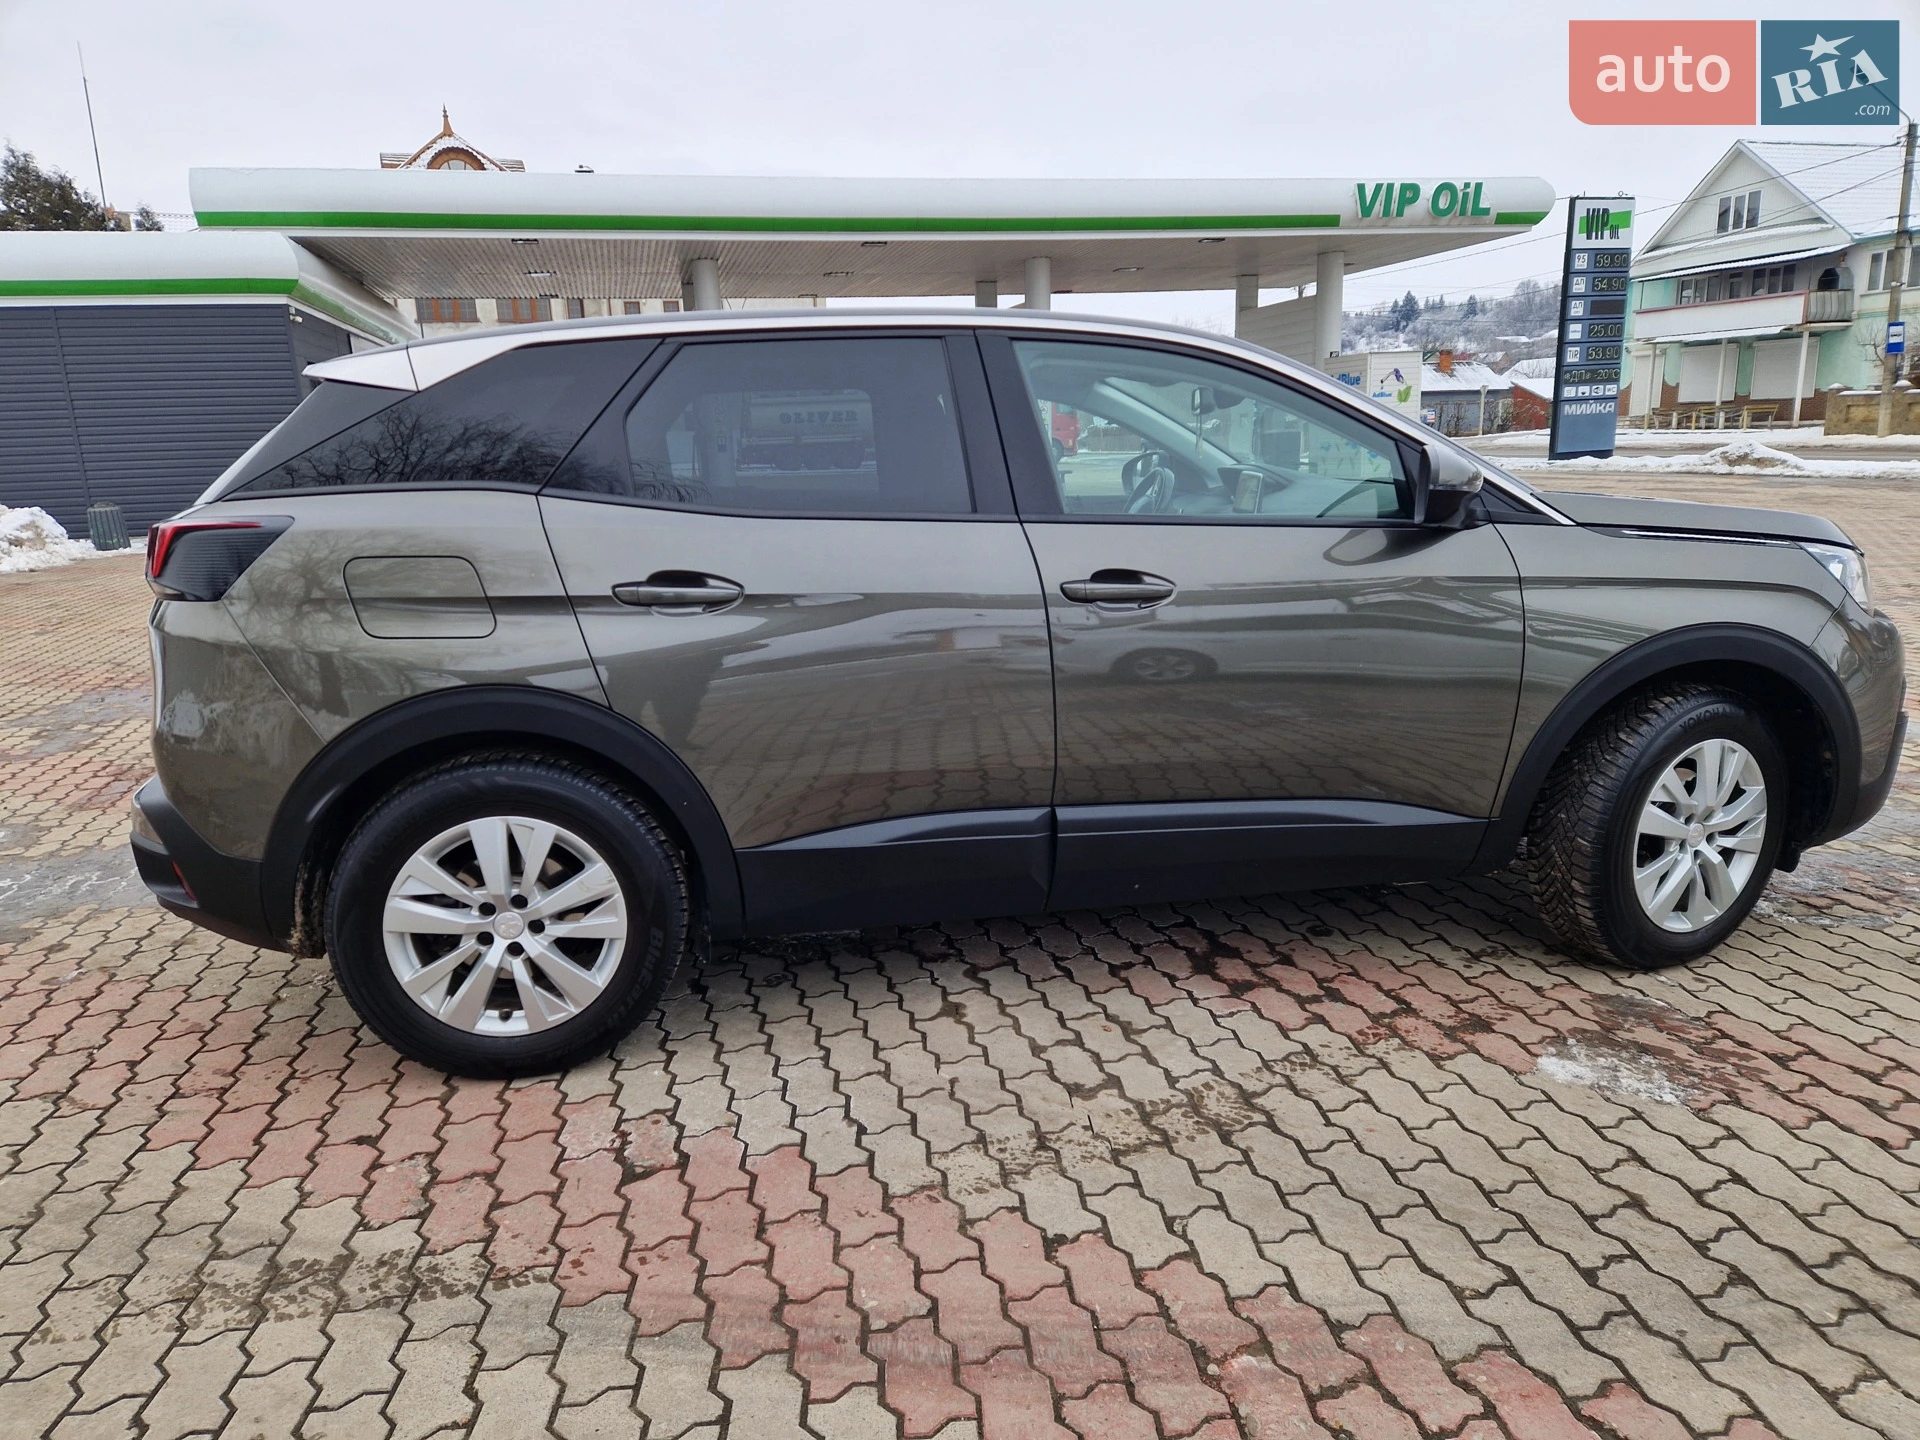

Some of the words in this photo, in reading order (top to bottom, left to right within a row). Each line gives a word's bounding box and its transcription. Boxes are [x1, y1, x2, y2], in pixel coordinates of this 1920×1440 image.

[1356, 182, 1421, 218] VIP
[1586, 207, 1610, 240] VIP
[1609, 224, 1620, 240] OIL
[1576, 254, 1587, 264] 95
[1596, 253, 1628, 268] 59.90
[1594, 277, 1626, 291] 54.90
[1589, 323, 1622, 337] 25.00
[1568, 349, 1579, 360] TIR
[1588, 346, 1620, 360] 53.90
[1564, 400, 1616, 416] МИЙКА
